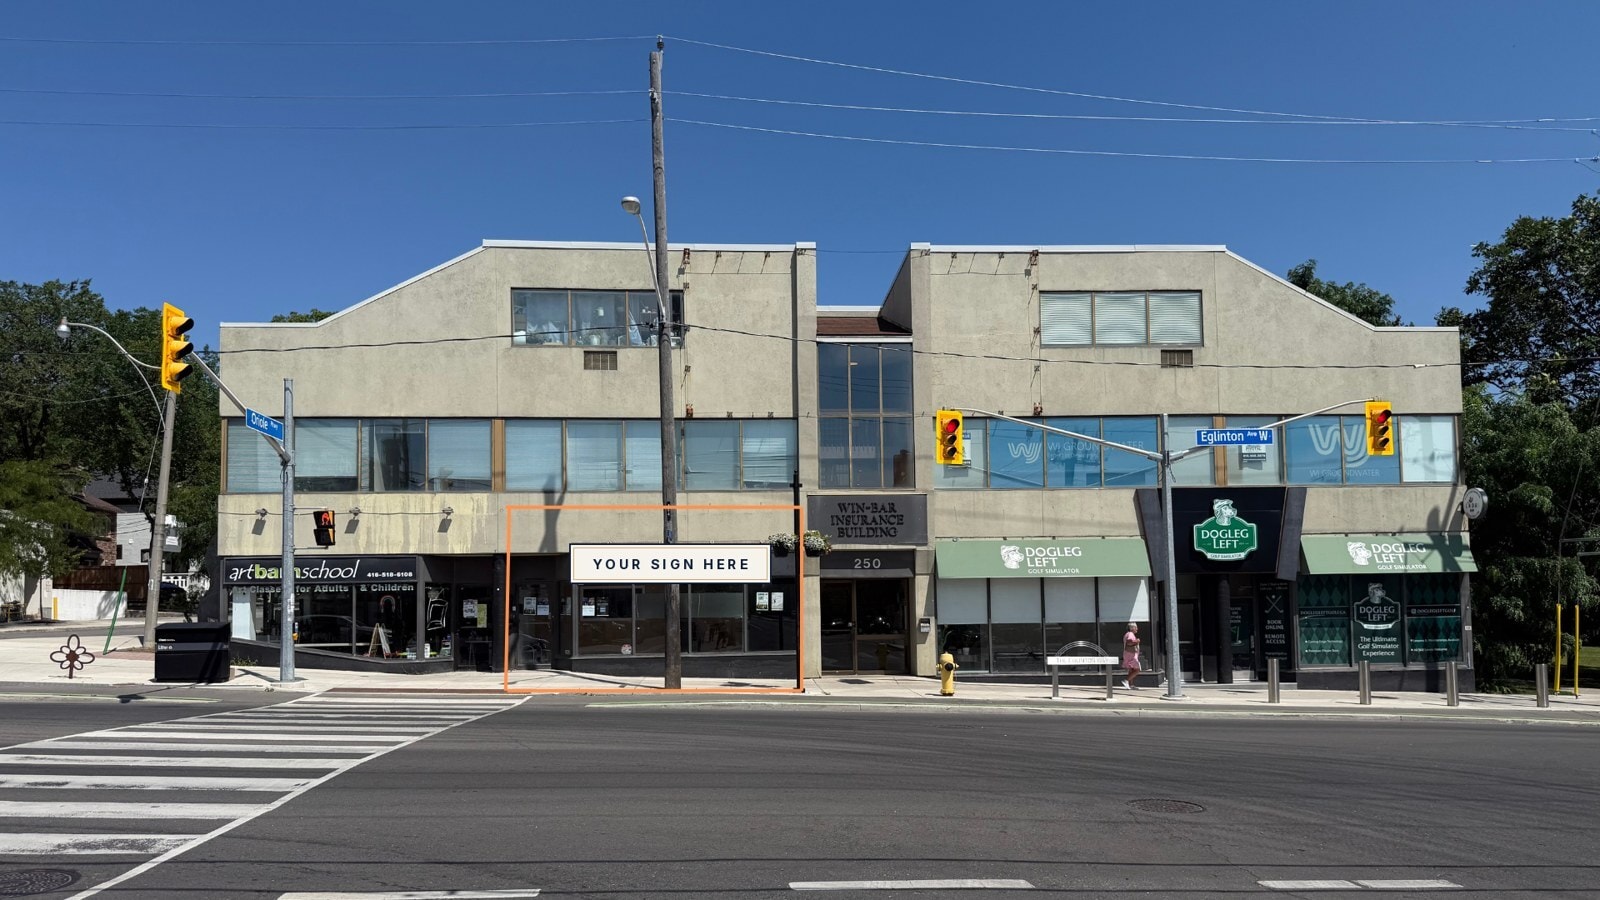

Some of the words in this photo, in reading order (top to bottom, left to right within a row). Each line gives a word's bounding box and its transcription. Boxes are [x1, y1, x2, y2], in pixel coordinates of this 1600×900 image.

[1201, 430, 1244, 444] Eglinton
[1259, 430, 1268, 441] W
[1063, 440, 1144, 451] GROUNTER
[837, 502, 897, 513] WIN-BAR
[830, 514, 904, 526] INSURANCE
[837, 526, 898, 538] BUILDING
[1201, 528, 1249, 539] DOGLEG
[1213, 538, 1240, 549] LEFT
[1371, 543, 1427, 554] DOGLEG
[1025, 546, 1082, 557] DOGLEG
[854, 558, 881, 569] 250
[1027, 557, 1058, 567] LEFT
[1374, 553, 1406, 564] LEFT
[250, 585, 282, 593] Classe
[296, 585, 311, 593] for
[314, 584, 349, 593] Adults
[371, 583, 414, 592] Children
[1359, 605, 1395, 614] DOGLEG
[1368, 613, 1388, 621] LEFT
